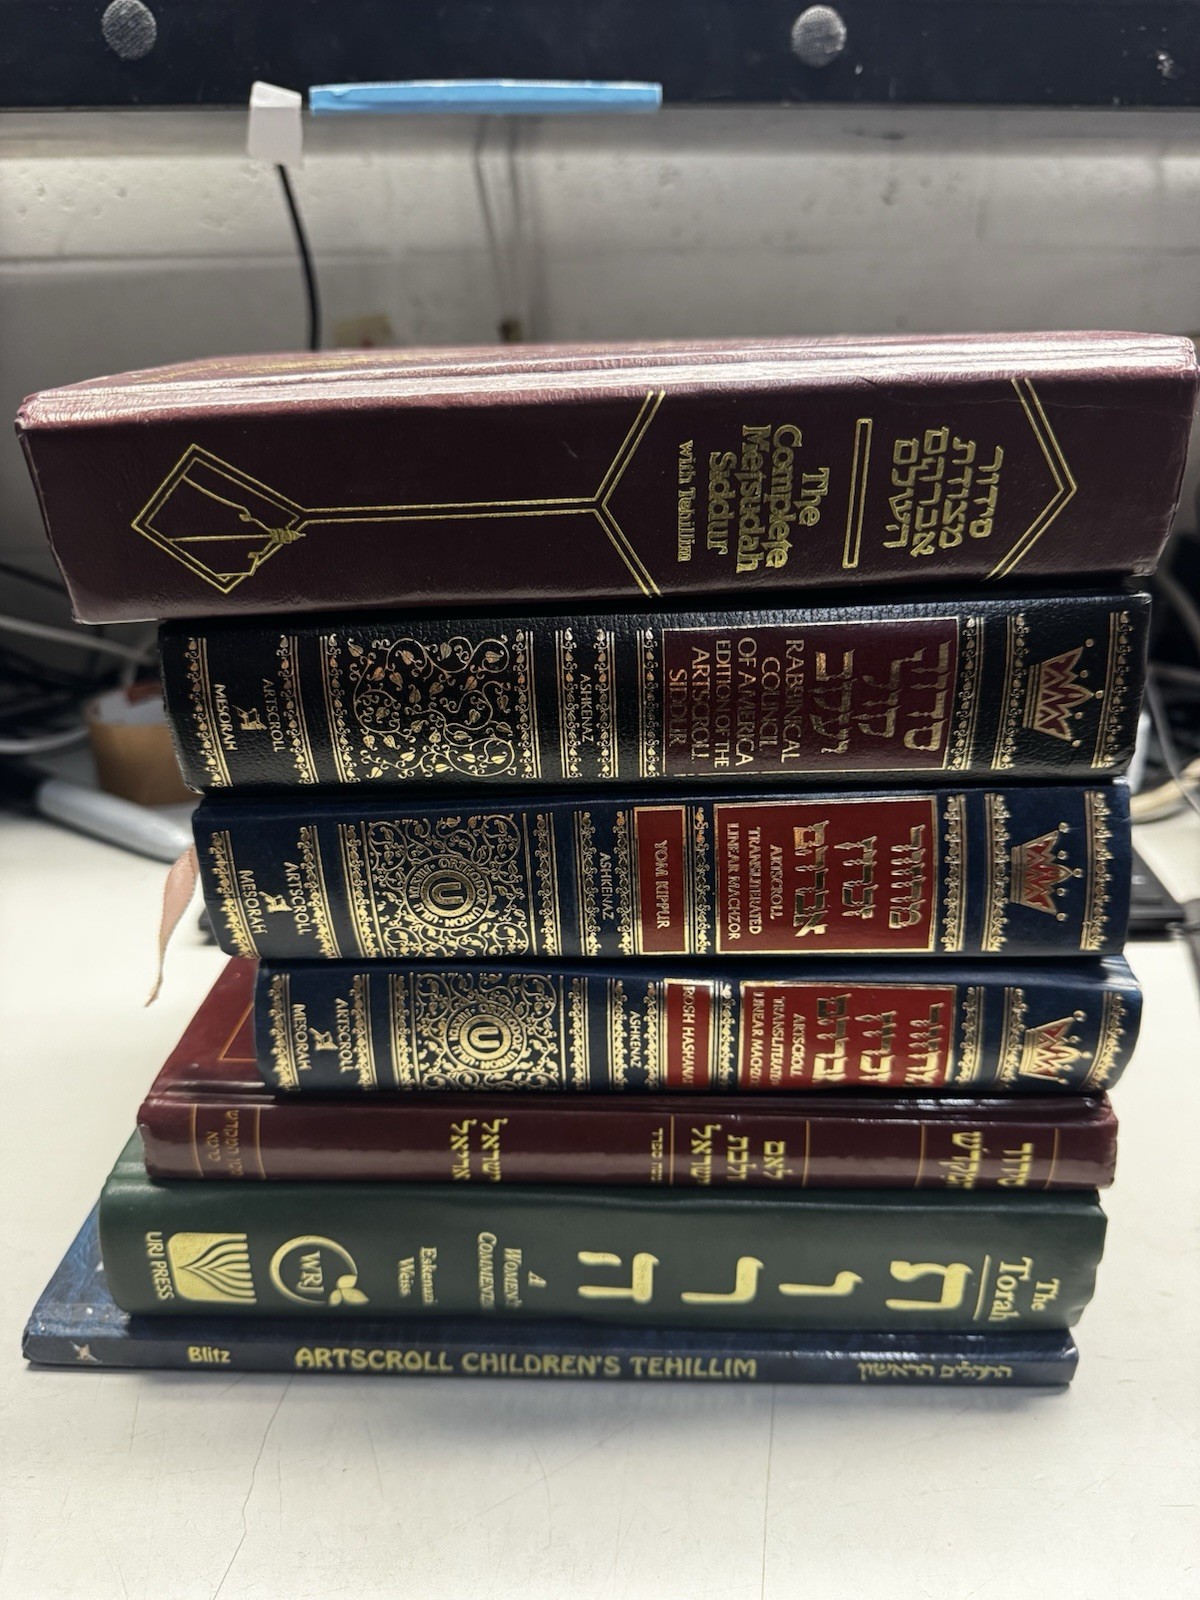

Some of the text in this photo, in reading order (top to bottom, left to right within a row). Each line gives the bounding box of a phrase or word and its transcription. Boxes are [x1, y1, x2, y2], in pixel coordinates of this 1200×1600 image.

[677, 439, 697, 563] with Tehillim
[707, 451, 737, 555] Siddur
[735, 424, 772, 574] Metsudah
[760, 424, 803, 570] Complete
[796, 467, 830, 527] The
[882, 438, 919, 549] השלם
[910, 426, 949, 557] אברהם
[938, 436, 976, 549] מצודת
[969, 445, 1004, 539] סידור
[214, 684, 238, 750] MESORAH
[262, 678, 286, 753] ARTSCROLL
[580, 673, 594, 743] ASHKENAZ
[668, 669, 688, 748] SIDDUR
[691, 646, 711, 763] ARTSCROLL
[714, 639, 732, 768] EDITION OF THE
[735, 636, 757, 766] OF AMERICA
[759, 656, 780, 748] COUNCIL
[780, 639, 804, 763] RABBINICAL
[851, 647, 927, 738] קול
[903, 640, 952, 751] סדור
[239, 870, 268, 934] MESORAH
[284, 862, 312, 935] ARTSCROLL
[600, 852, 614, 921] ASHKENAZ
[654, 839, 670, 930] YOM KIPPUR
[727, 822, 741, 940] LINEAR MACHZOR
[748, 826, 762, 934] TRANSLITERATED
[769, 844, 783, 920] ARTSCROLL
[793, 820, 830, 937] אברהם
[834, 835, 879, 919] זכרון
[888, 824, 927, 929] מחזור
[292, 1003, 312, 1071] MESORAH
[335, 997, 354, 1074] ARTSCROLL
[629, 1011, 642, 1068] ASHKENAZ
[682, 985, 696, 1024] ROSH
[751, 991, 765, 1037] LINEAR
[790, 1013, 806, 1078] ARTSCROLL
[450, 1119, 478, 1179] אריאל
[481, 1118, 508, 1182] ישראל
[151, 1260, 174, 1301] PRESS
[296, 1250, 325, 1295] WRJ
[528, 1271, 547, 1288] A
[988, 1256, 1034, 1322] Torah
[1030, 1278, 1060, 1312] The
[187, 1346, 231, 1364] Blitz
[294, 1346, 758, 1378] ARTSCROLL CHILDREN'S TEHILLIM
